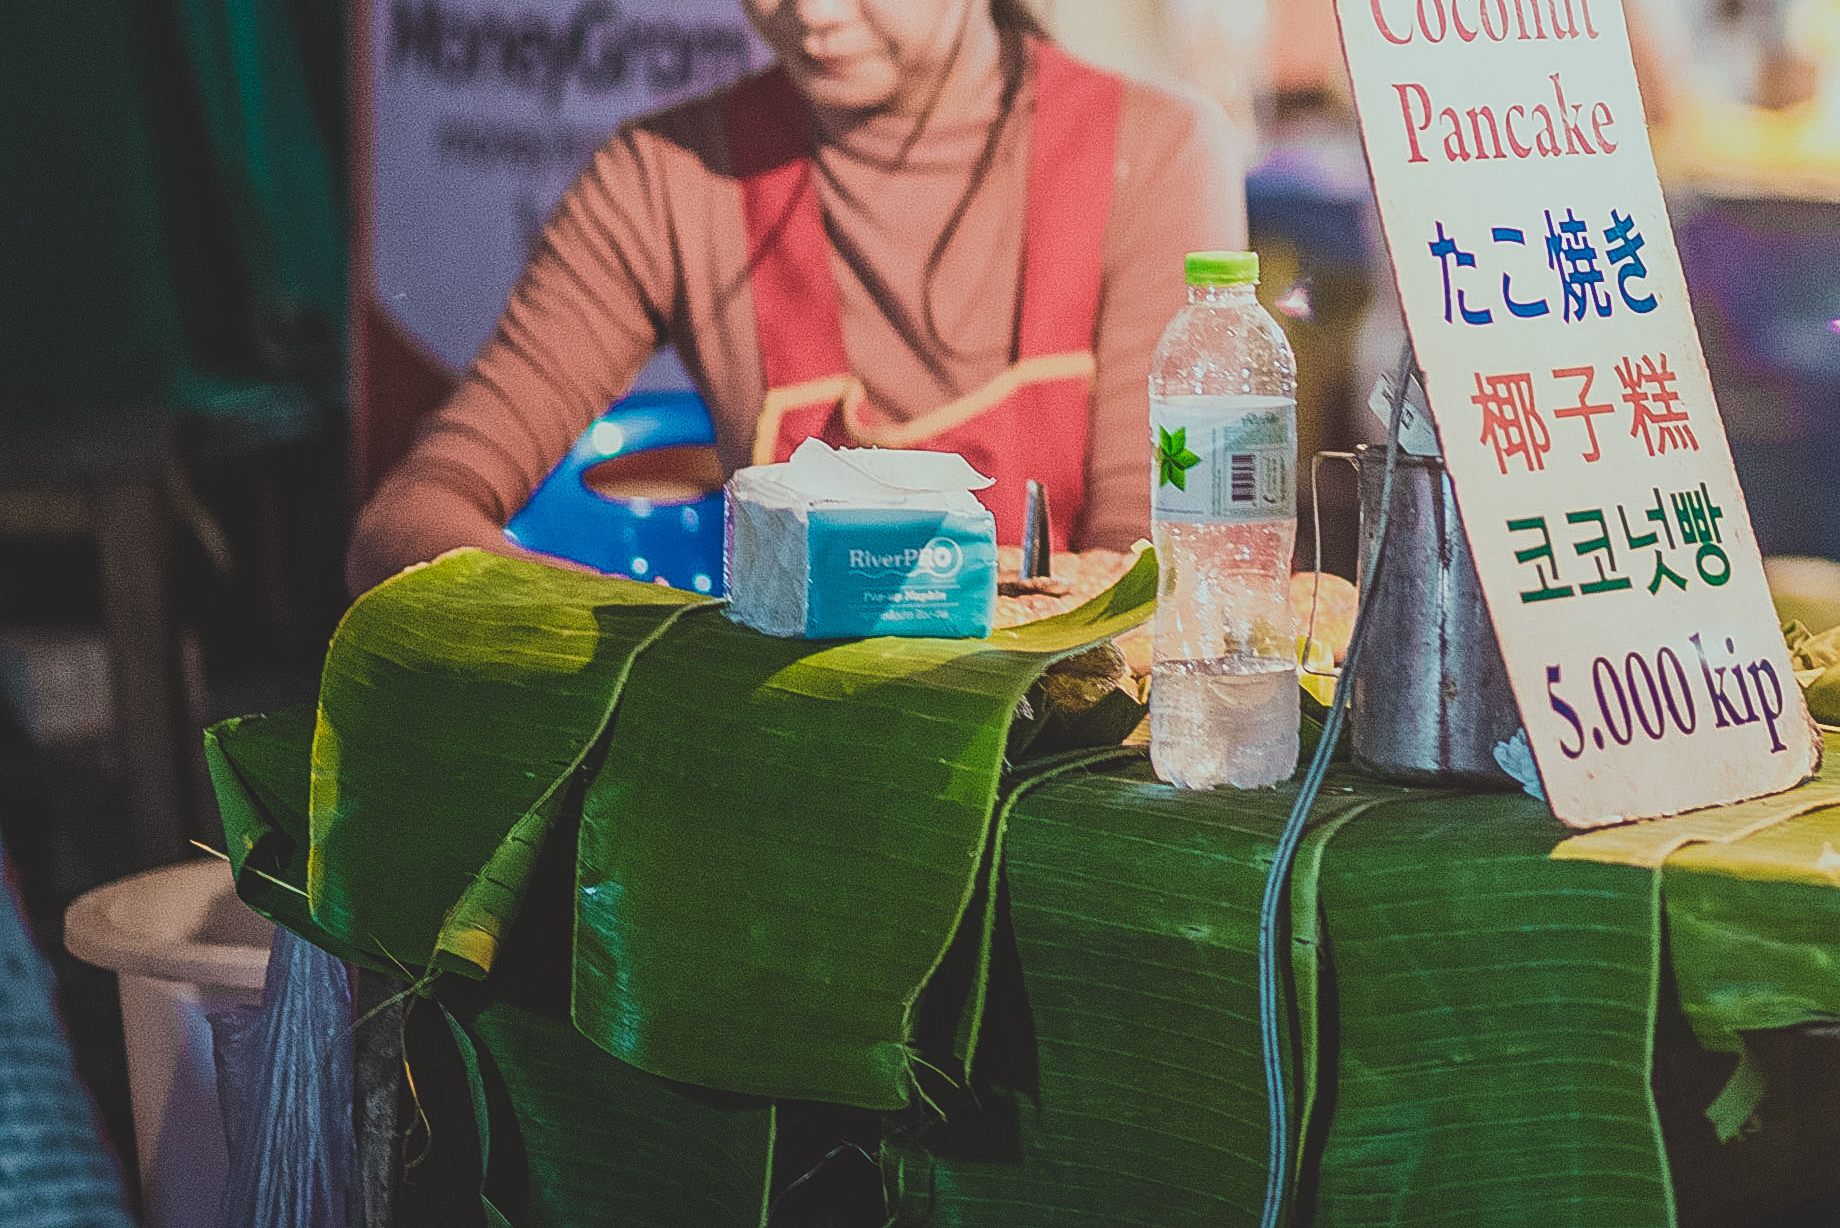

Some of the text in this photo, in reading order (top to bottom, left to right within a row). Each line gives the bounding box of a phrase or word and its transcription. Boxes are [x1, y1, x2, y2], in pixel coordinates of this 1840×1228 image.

[1391, 71, 1619, 163] Pancake
[1427, 207, 1658, 325] たこ焼き
[1470, 352, 1699, 475] 椰子糕
[1505, 481, 1732, 604] 코코넛빵
[1545, 631, 1788, 760] 5.000 kip
